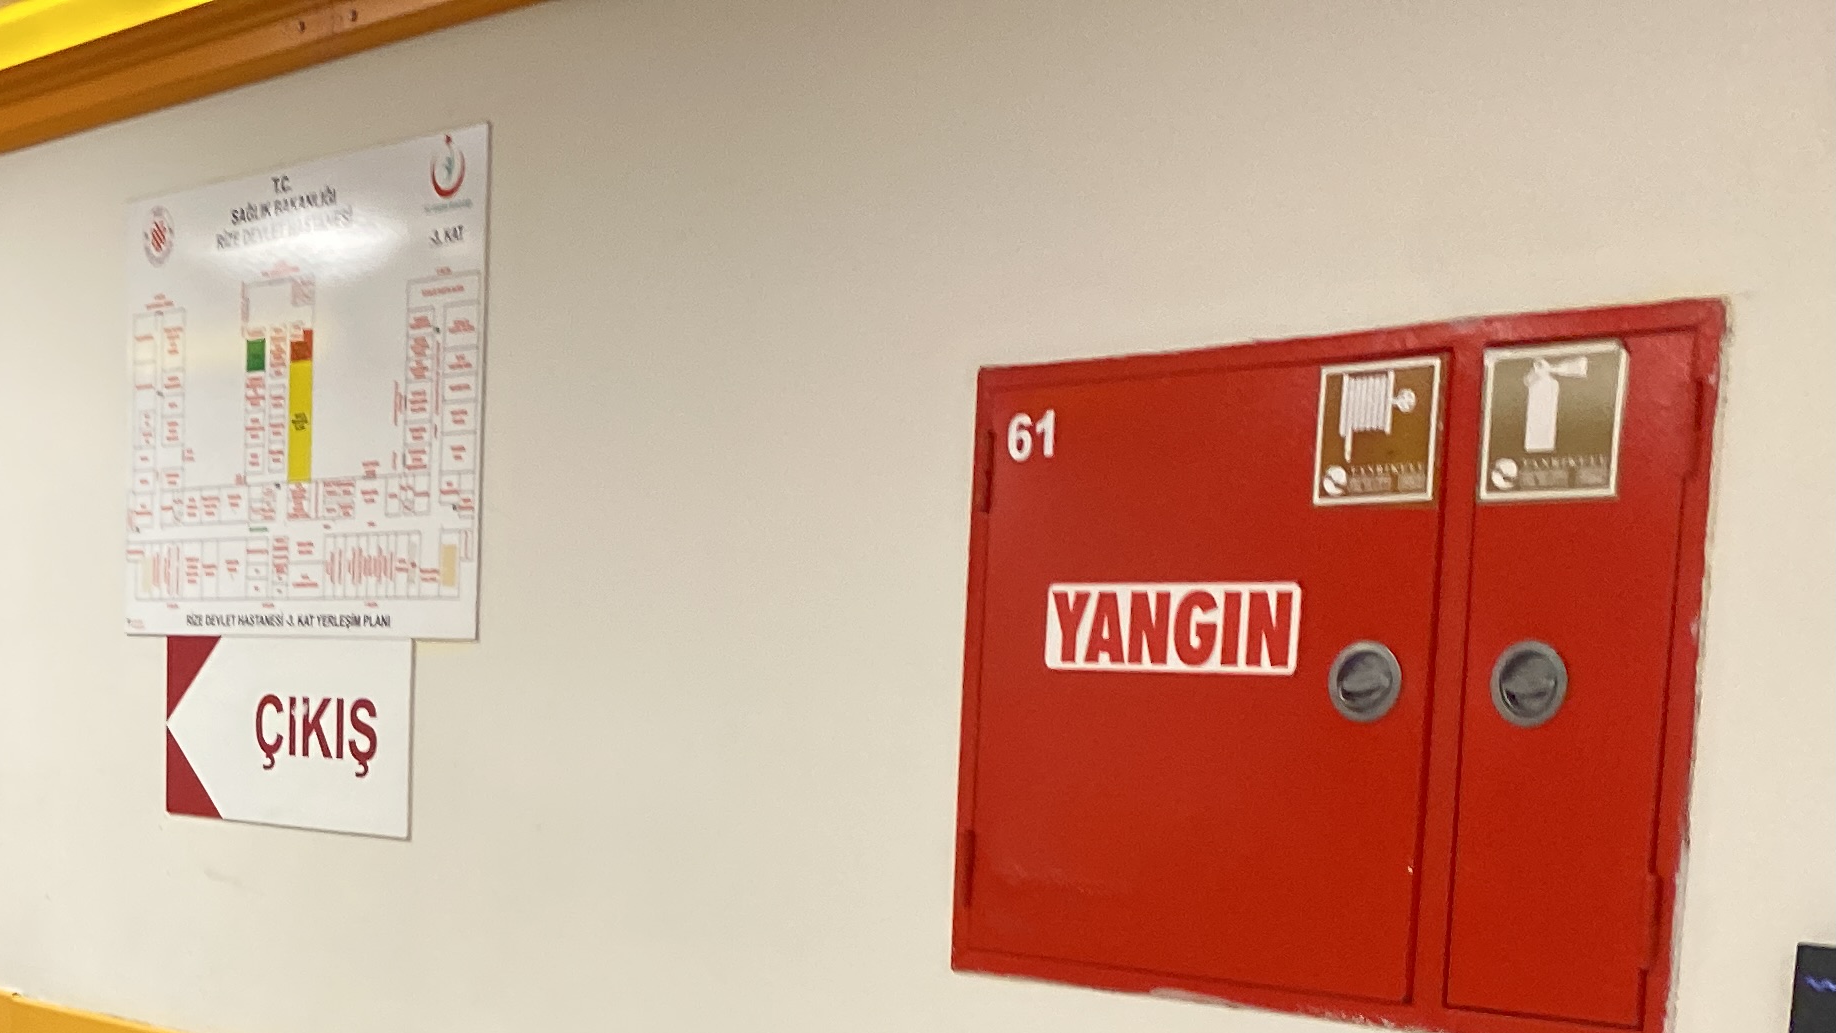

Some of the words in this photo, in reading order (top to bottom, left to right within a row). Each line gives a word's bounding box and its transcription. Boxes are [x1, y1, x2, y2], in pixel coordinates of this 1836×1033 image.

[1008, 409, 1055, 462] 61
[1053, 590, 1293, 668] YANGIN
[256, 694, 378, 779] ÇIKIŞ
